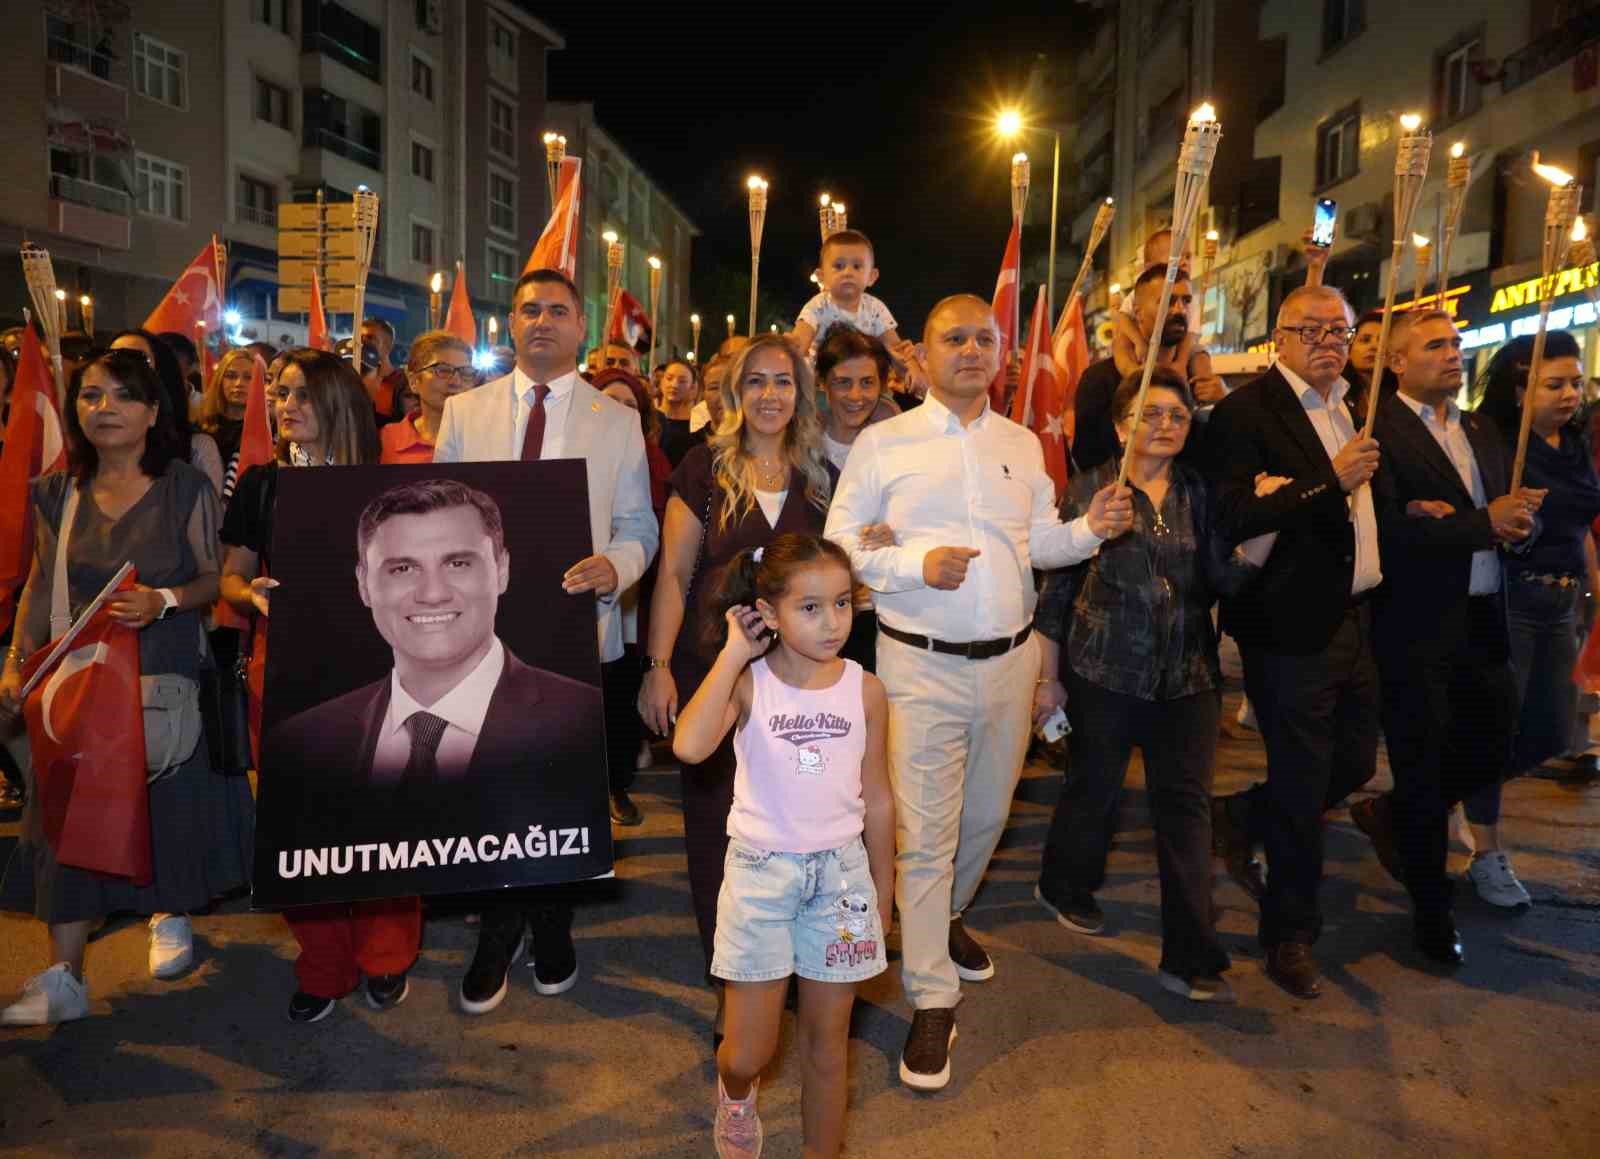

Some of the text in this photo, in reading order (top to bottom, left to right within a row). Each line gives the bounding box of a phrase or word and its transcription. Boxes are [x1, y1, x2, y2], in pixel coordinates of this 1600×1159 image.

[768, 712, 851, 732] Hello Kitty
[278, 824, 589, 879] UNUTMAYACAĞIZ!
